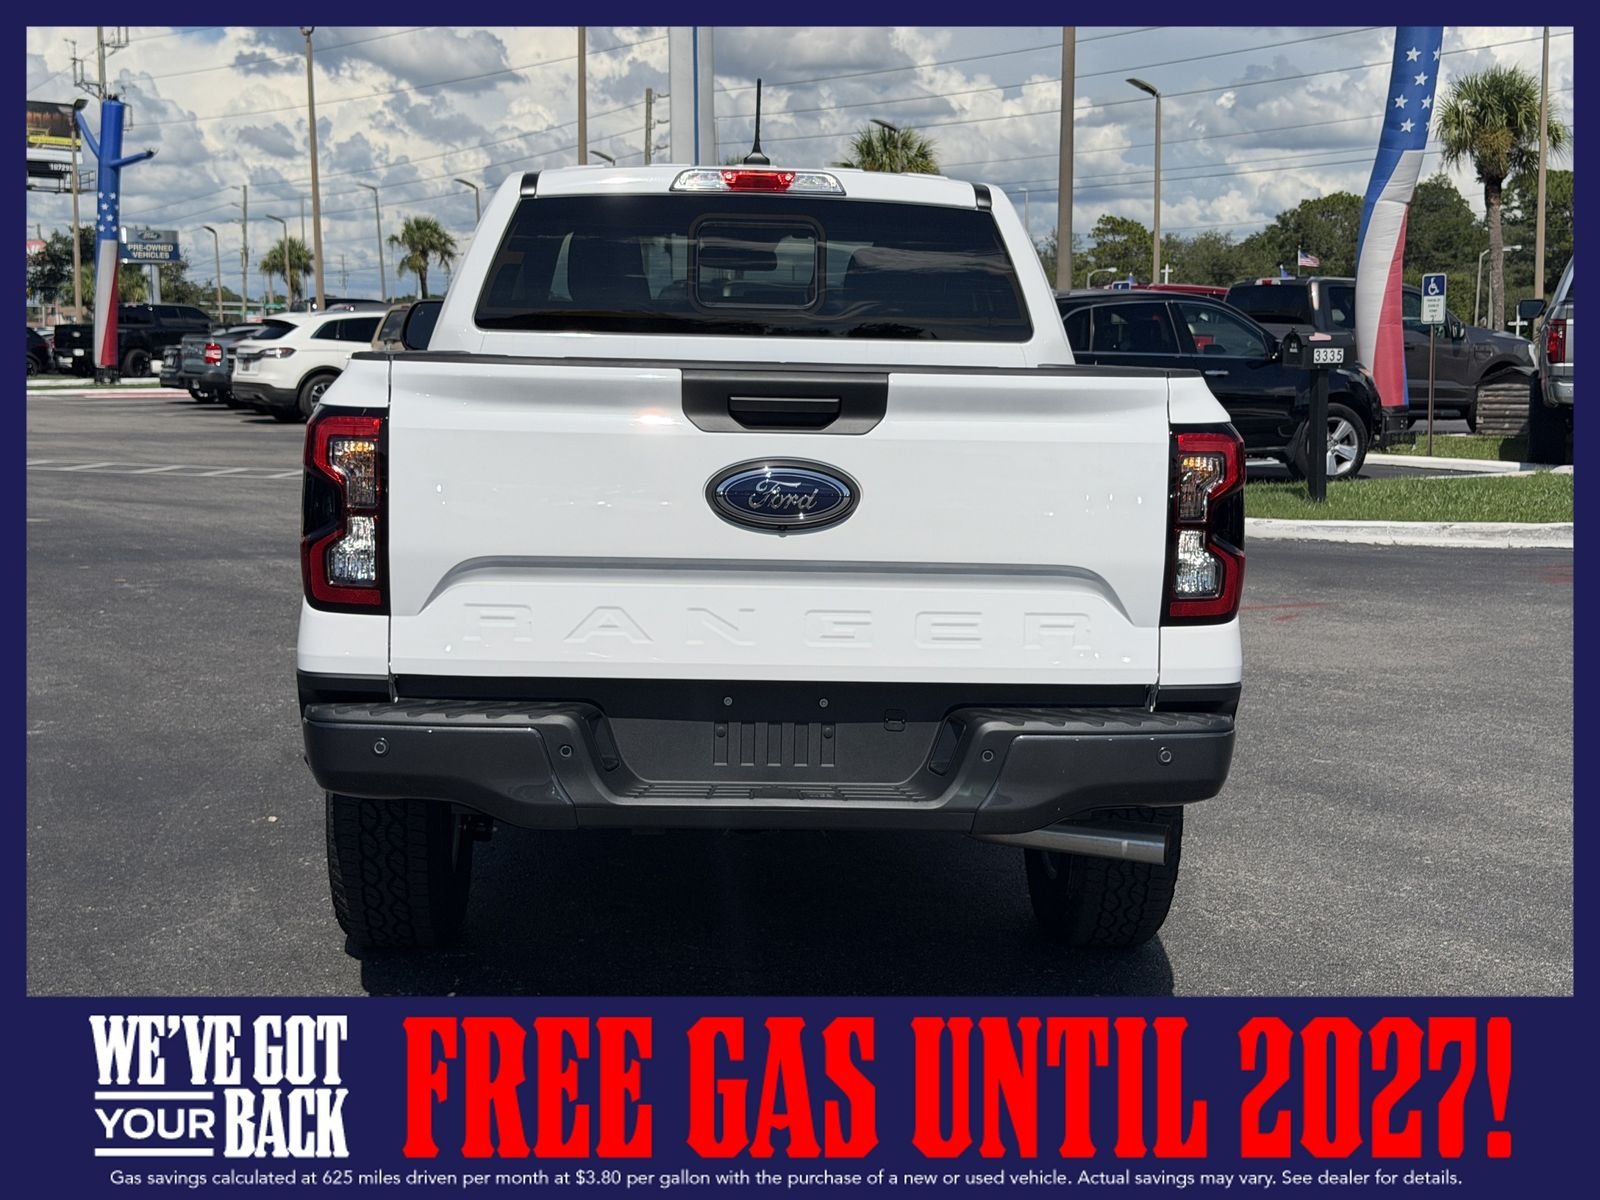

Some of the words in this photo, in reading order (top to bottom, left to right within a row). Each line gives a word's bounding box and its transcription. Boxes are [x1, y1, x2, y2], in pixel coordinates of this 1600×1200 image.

[128, 244, 173, 252] PRE-OWNED
[133, 251, 170, 259] VEHICLES
[1314, 349, 1343, 362] 3335
[748, 478, 819, 510] Ford
[463, 601, 1092, 650] RANGER
